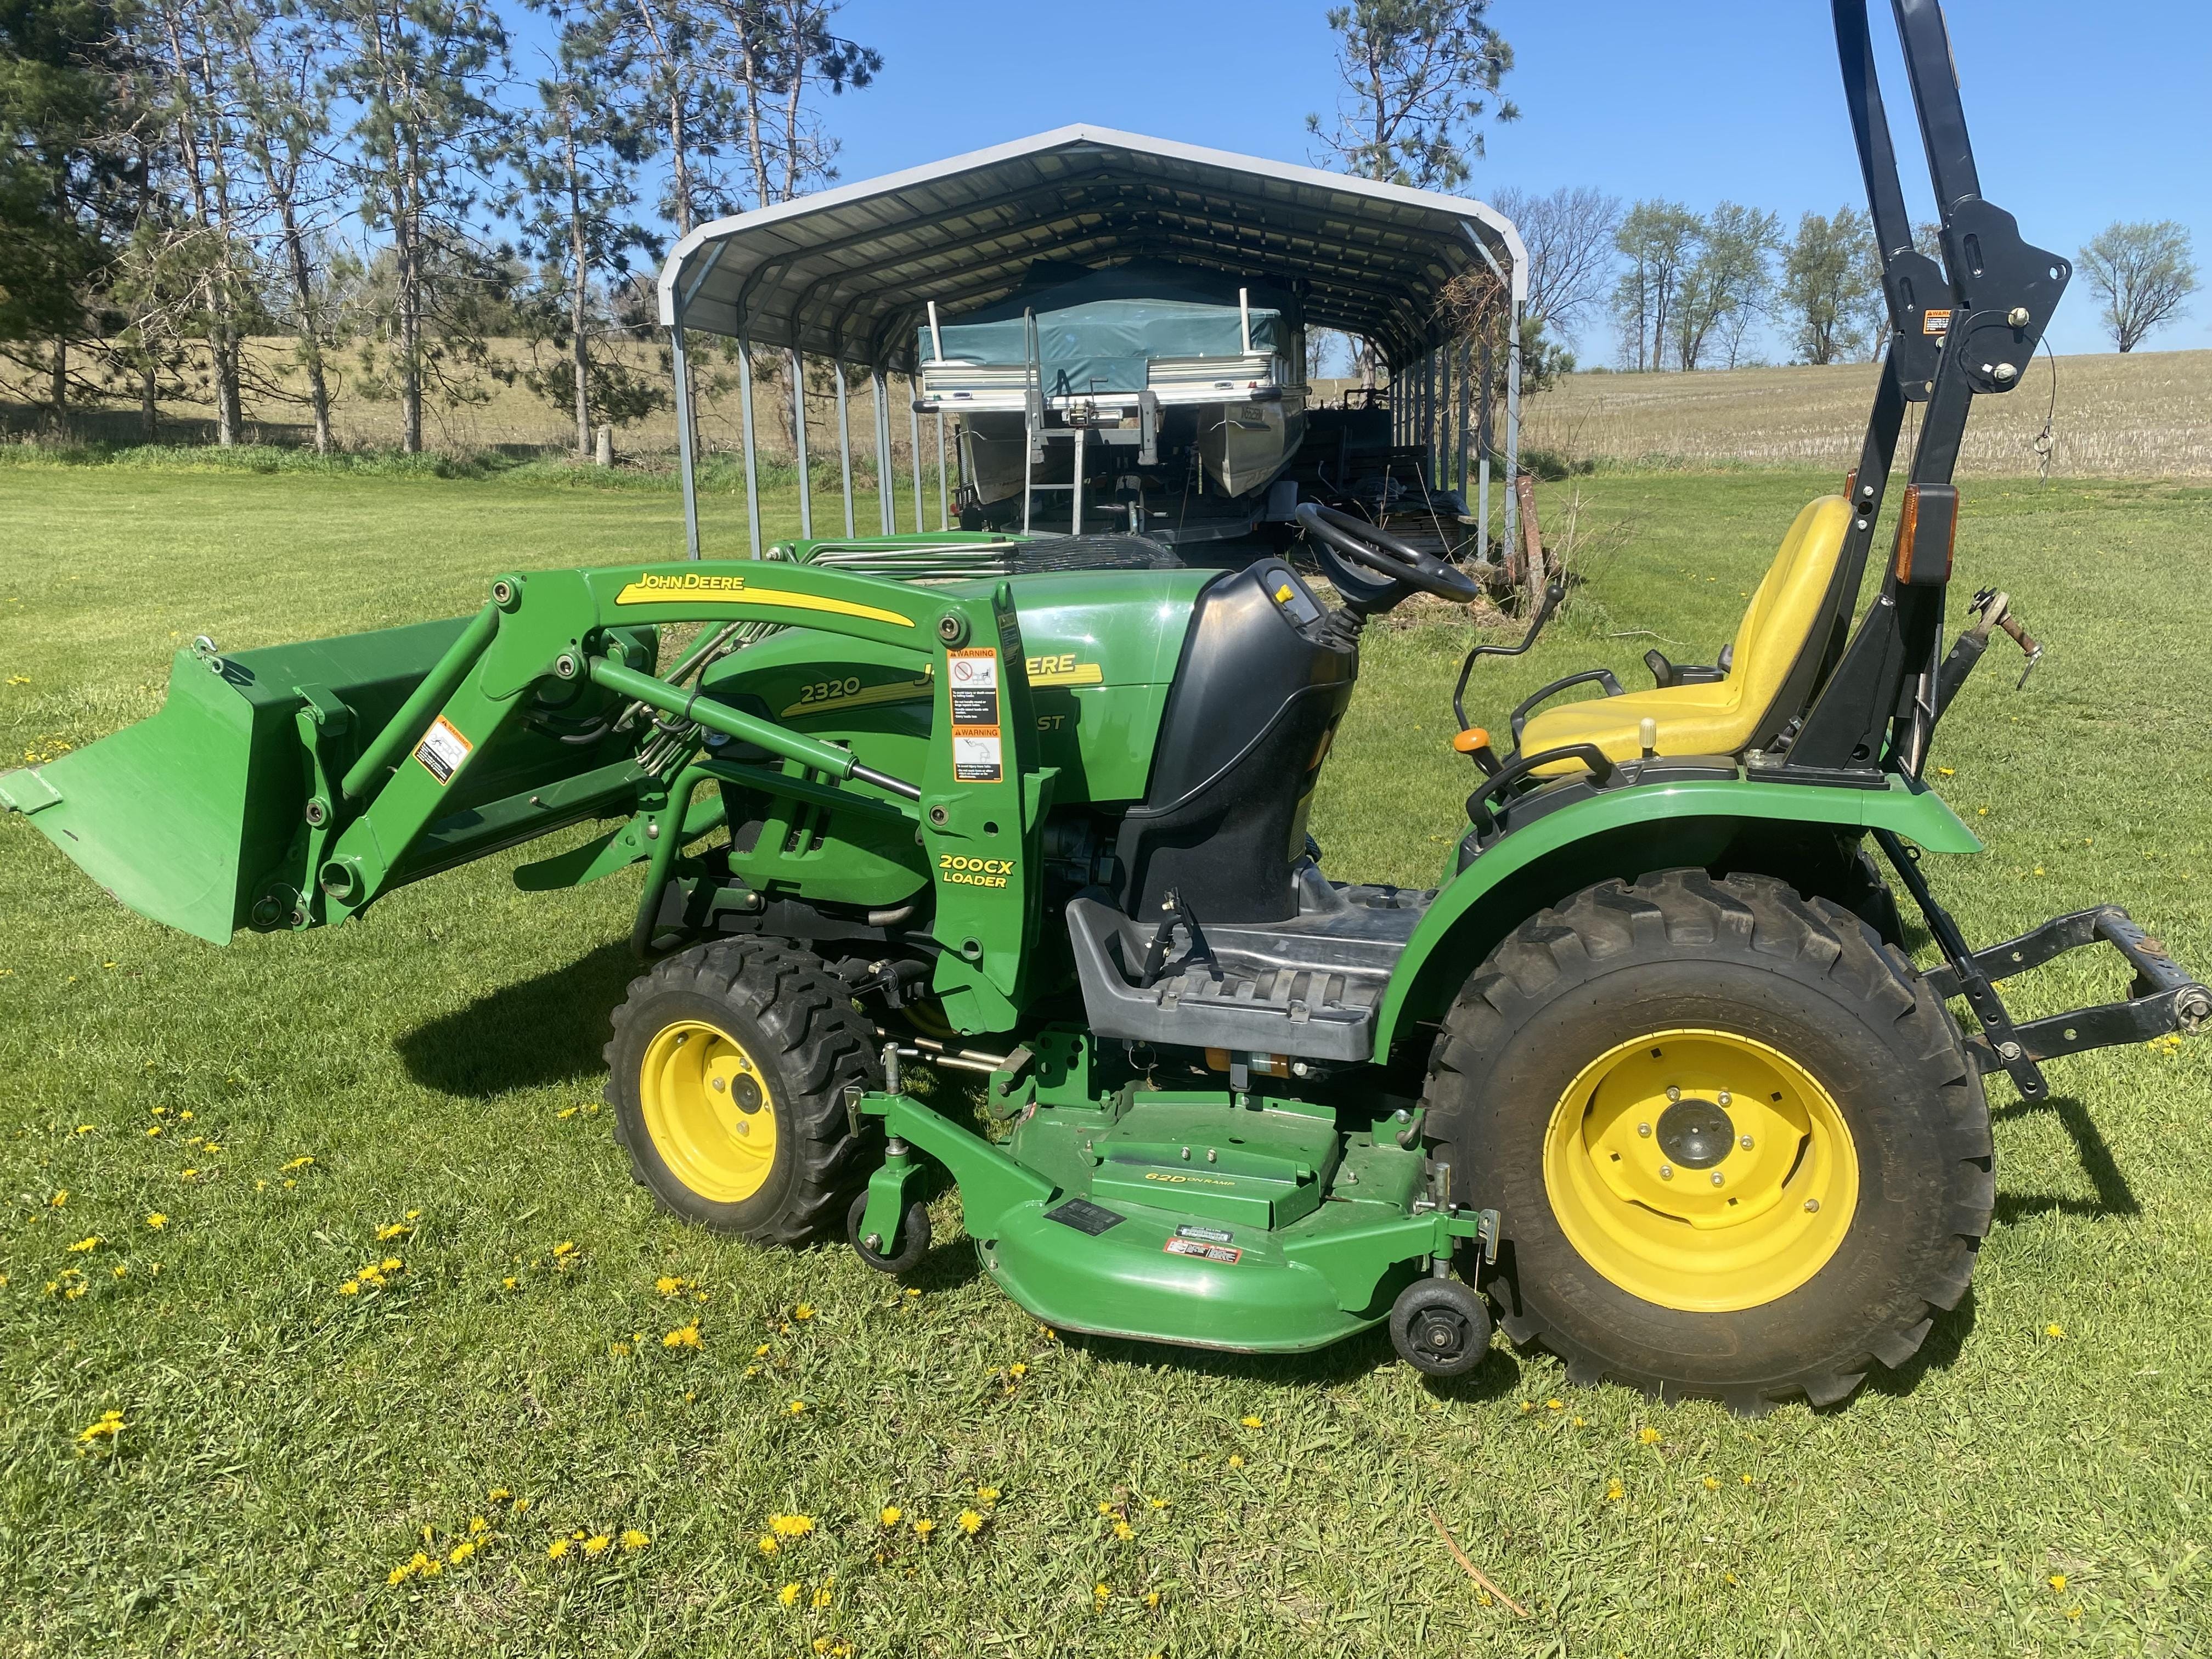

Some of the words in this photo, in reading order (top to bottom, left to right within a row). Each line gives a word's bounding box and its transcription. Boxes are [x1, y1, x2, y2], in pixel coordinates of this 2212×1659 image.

[635, 572, 683, 589] JOHN
[684, 573, 745, 590] DEERE
[913, 663, 934, 686] J
[800, 676, 860, 704] 2320
[448, 725, 469, 747] WARNING
[939, 854, 1016, 876] 200CX
[943, 871, 1007, 889] LOADER
[1144, 1173, 1187, 1183] 62D
